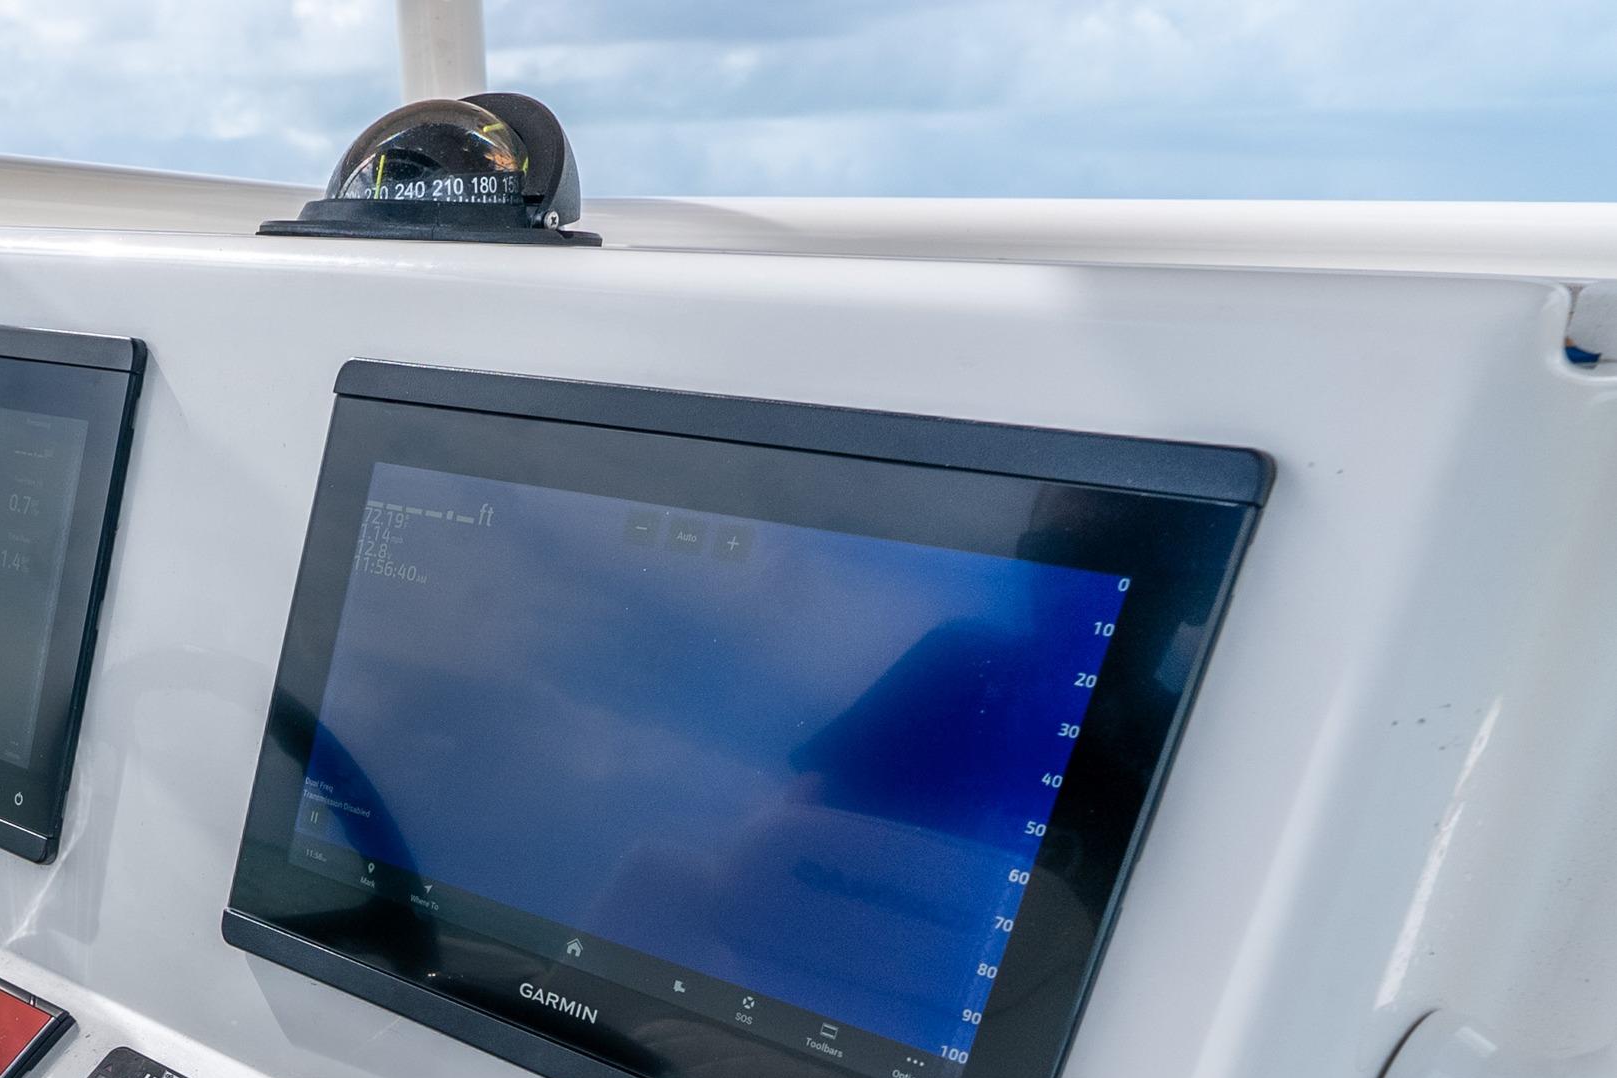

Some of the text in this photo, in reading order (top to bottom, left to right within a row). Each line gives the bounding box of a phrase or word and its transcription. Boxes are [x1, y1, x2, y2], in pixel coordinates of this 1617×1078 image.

[395, 176, 498, 199] 240 210 180
[9, 493, 32, 515] 0.7
[365, 507, 404, 529] 72.19
[676, 531, 698, 544] Auto
[354, 555, 417, 581] 11:56:40
[1117, 577, 1131, 592] 0
[1094, 621, 1115, 637] 10
[1074, 672, 1097, 689] 20
[1058, 722, 1080, 739] 30
[1042, 772, 1063, 789] 40
[1024, 821, 1046, 838] 50
[360, 876, 375, 889] Mark
[1008, 869, 1029, 885] 60
[994, 916, 1014, 933] 70
[977, 962, 998, 979] 80
[519, 982, 599, 1024] GARMIN
[735, 1012, 753, 1025] SOS
[962, 1008, 982, 1025] 90
[806, 1037, 843, 1058] Toolbars
[940, 1045, 969, 1064] 100
